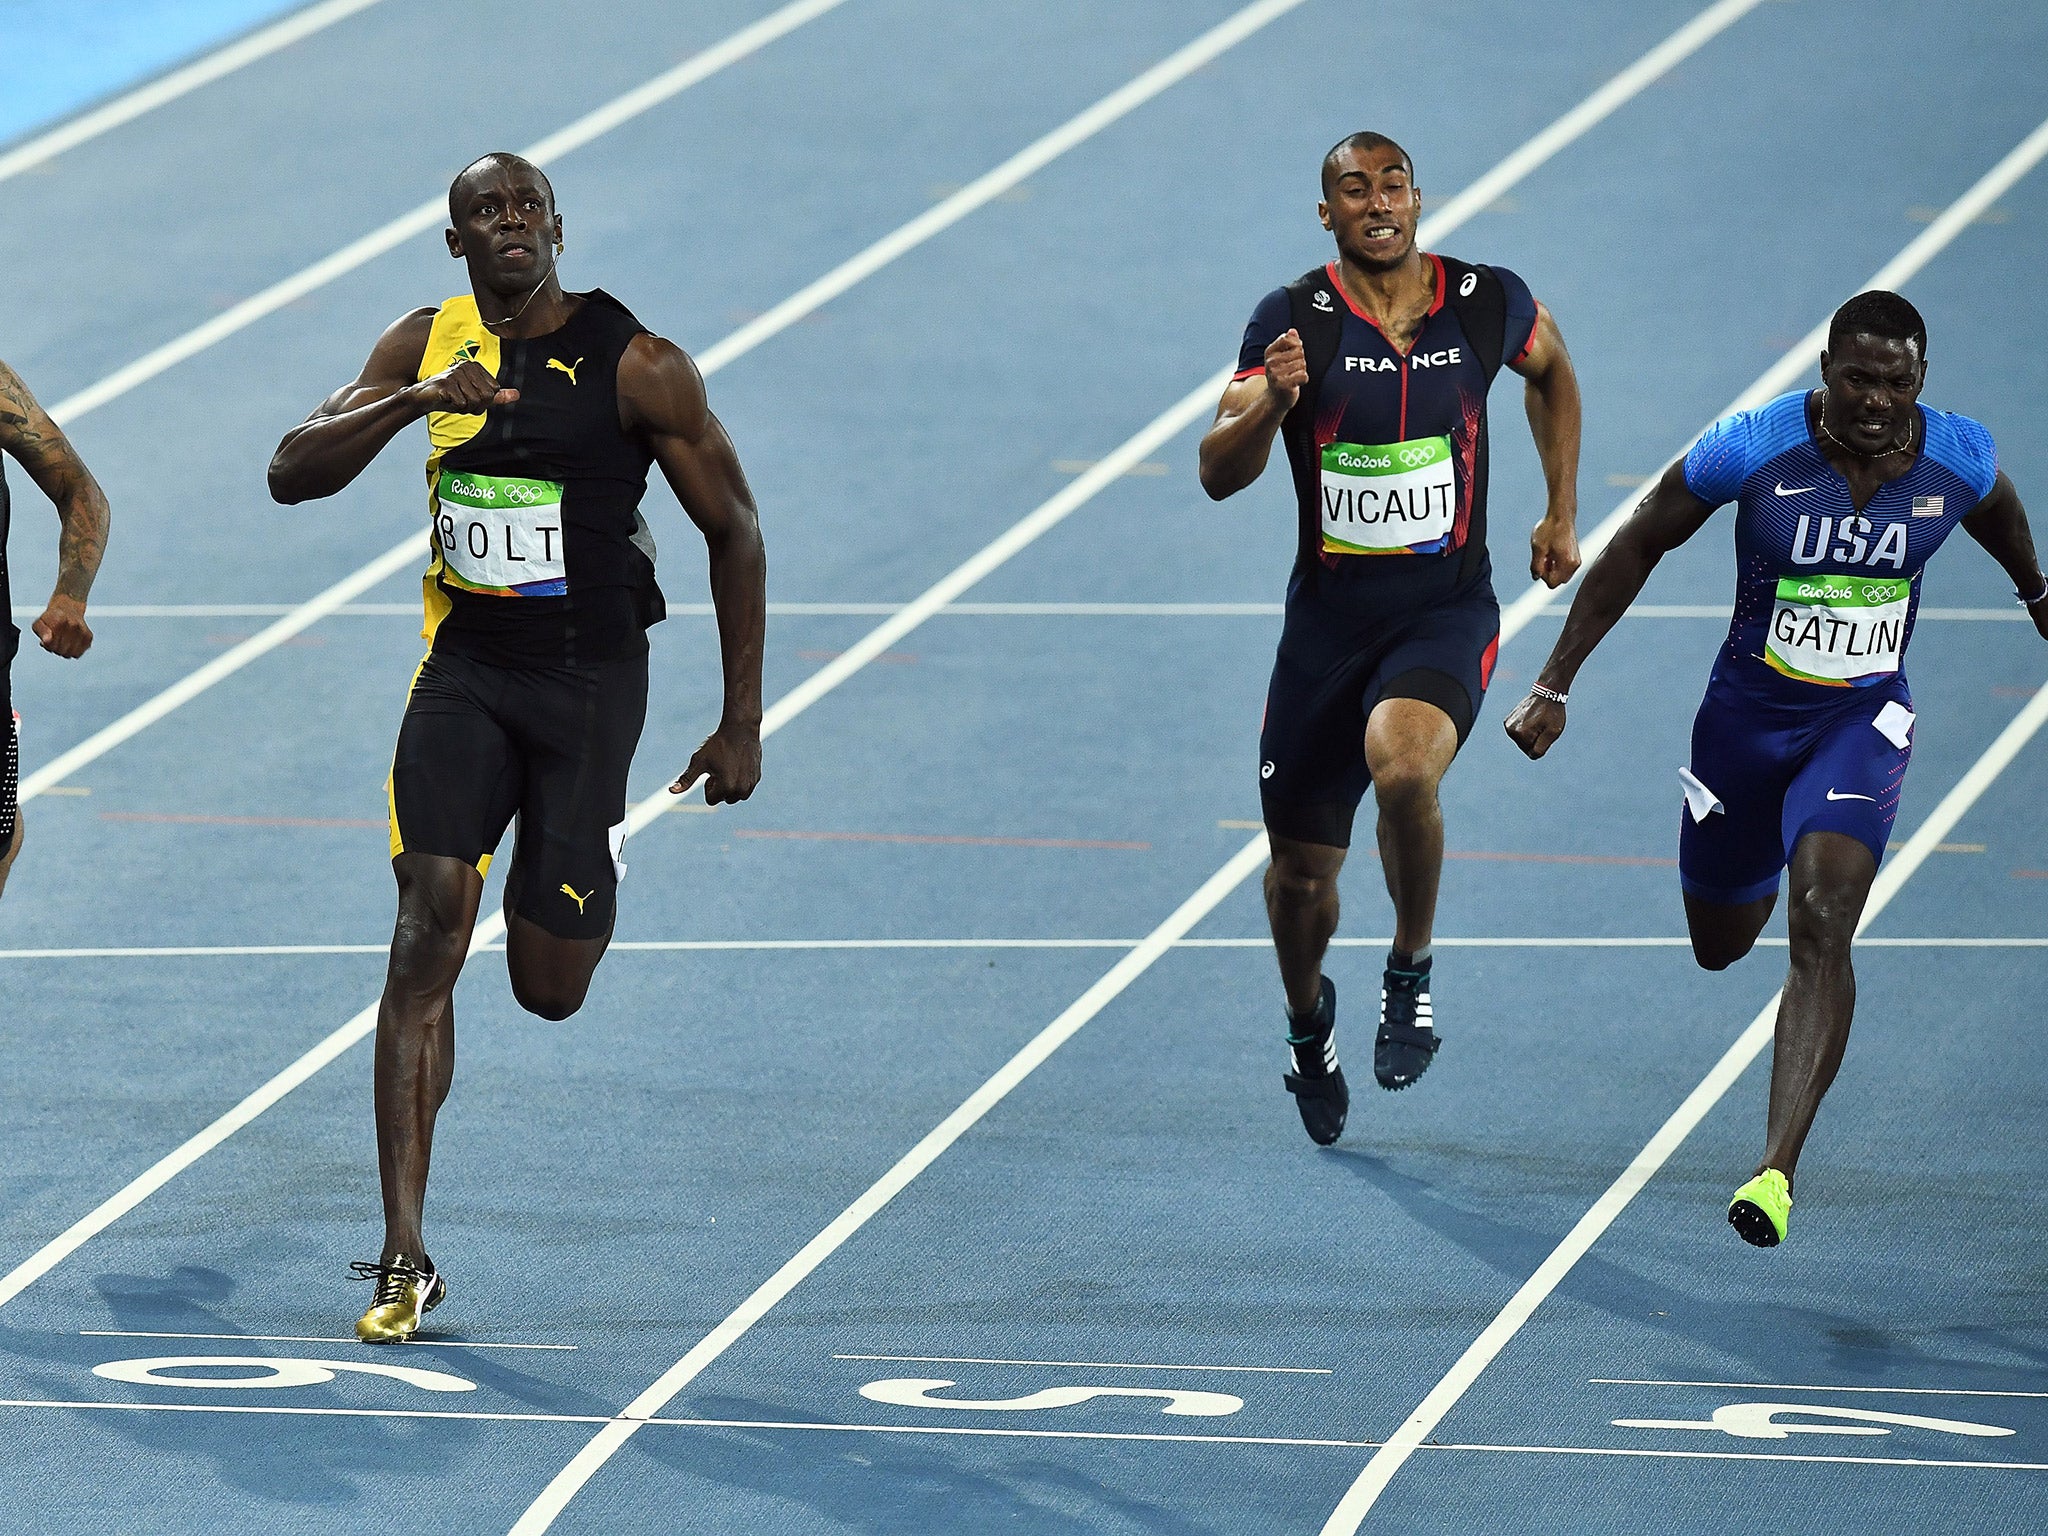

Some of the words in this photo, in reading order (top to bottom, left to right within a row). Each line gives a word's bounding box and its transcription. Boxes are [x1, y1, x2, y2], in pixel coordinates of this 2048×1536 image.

[1344, 347, 1462, 372] FRANCE
[1338, 453, 1391, 468] Rio2016
[452, 479, 496, 499] Rio2016
[1323, 482, 1452, 523] VICAUT
[440, 515, 559, 562] BOLT
[1791, 515, 1907, 569] USA
[1798, 584, 1852, 599] Rio2016
[1775, 608, 1899, 656] GATLIN
[92, 1357, 476, 1392] 6
[859, 1378, 1244, 1417] 5
[1611, 1402, 2017, 1439] 4
